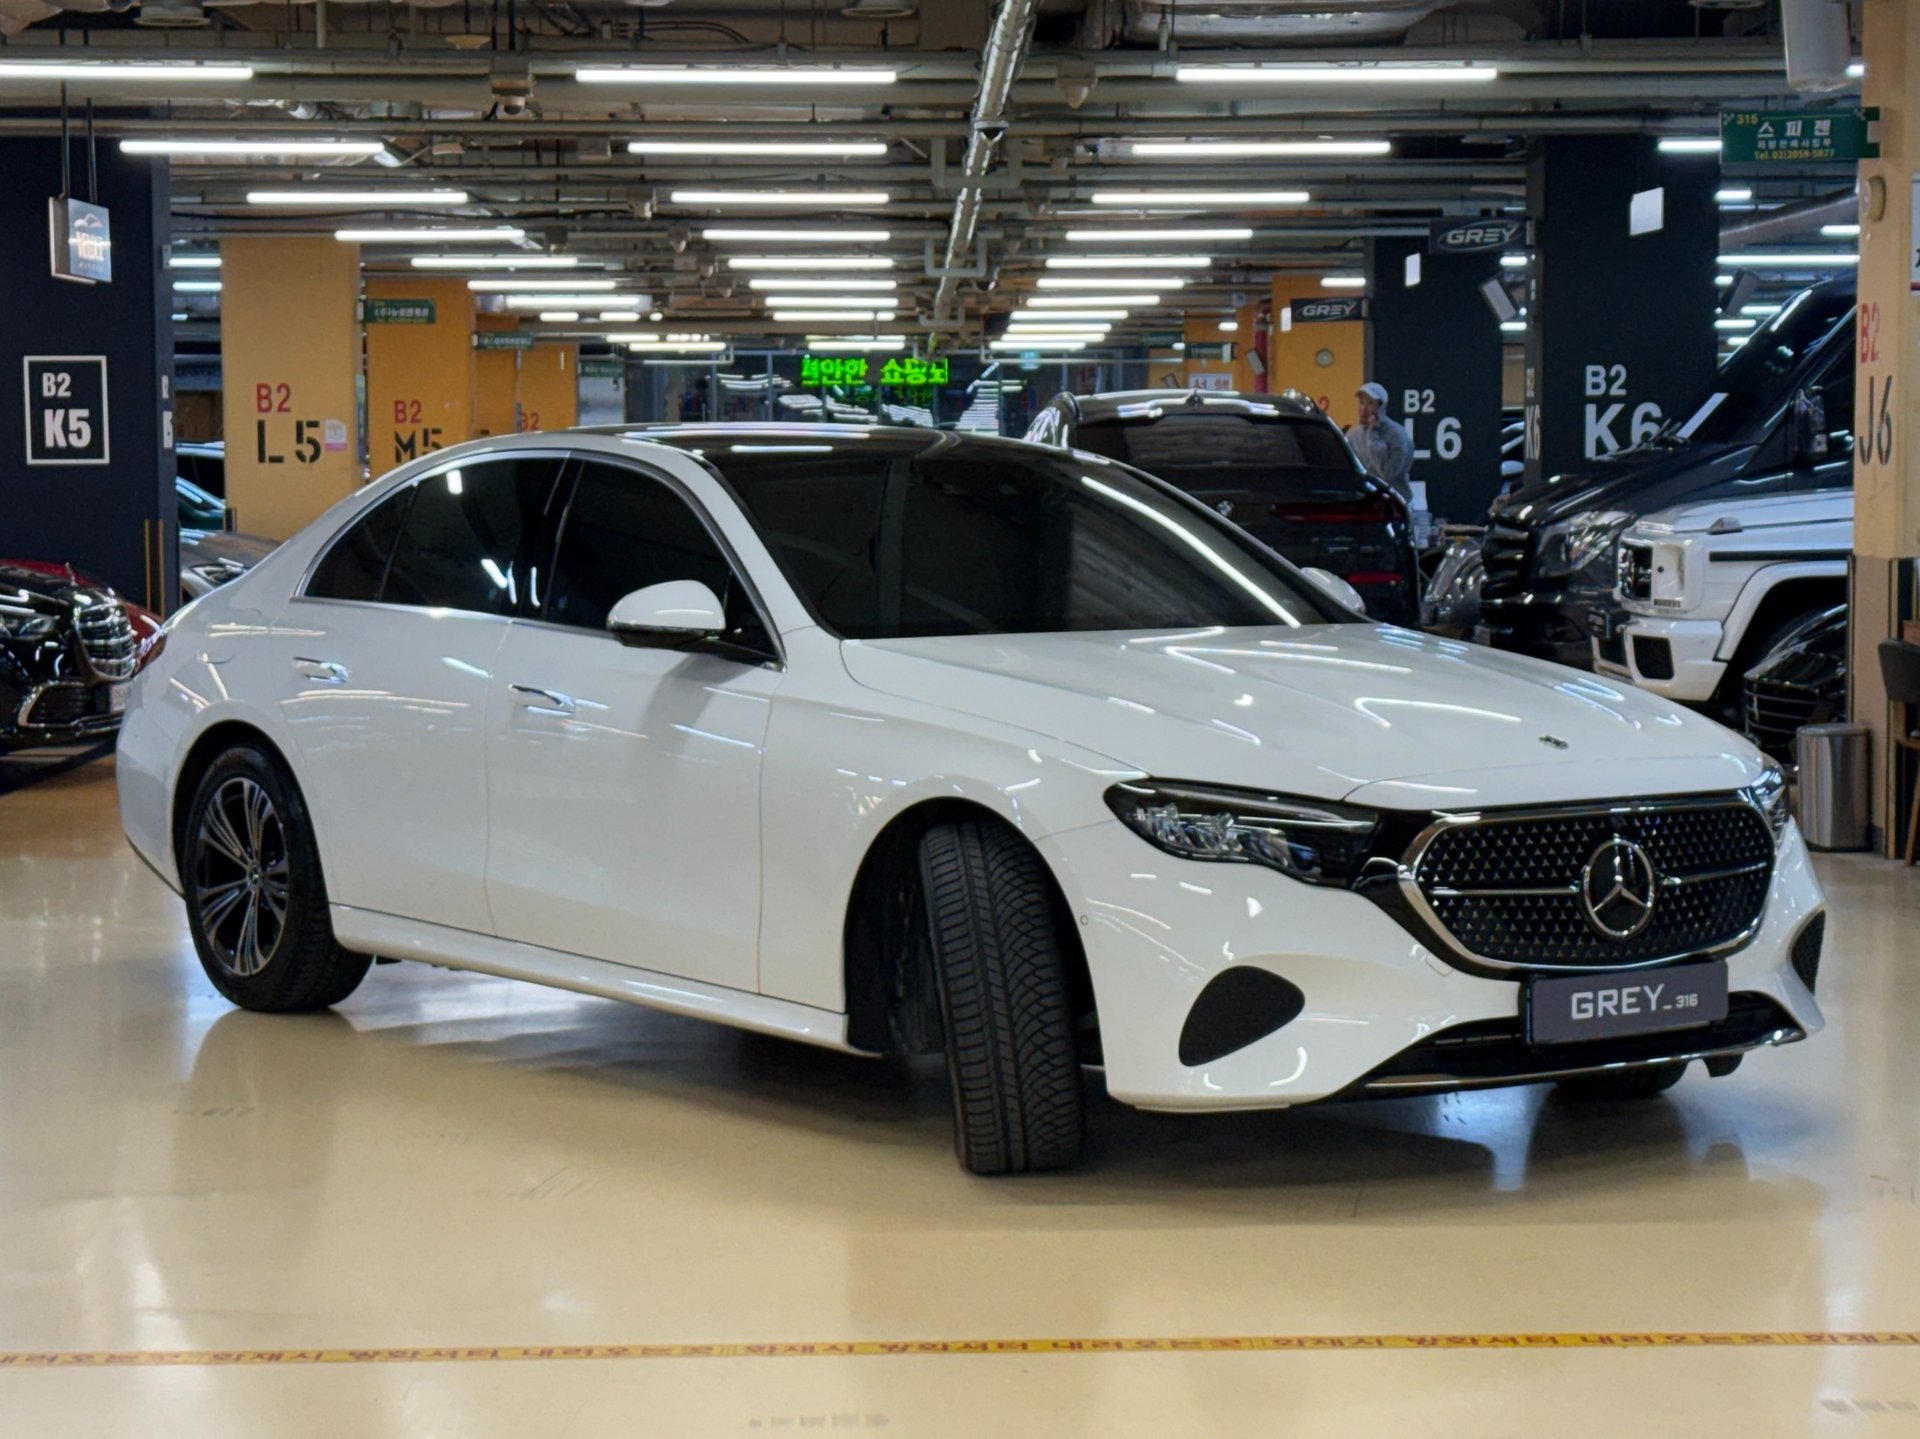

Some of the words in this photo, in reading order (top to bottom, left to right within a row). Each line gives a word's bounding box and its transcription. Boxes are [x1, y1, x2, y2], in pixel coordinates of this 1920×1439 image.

[1446, 223, 1518, 244] GREY
[1302, 303, 1355, 318] GREY
[1860, 303, 1880, 363] B2
[42, 372, 72, 397] B2
[1585, 364, 1627, 396] B2
[256, 383, 292, 413] B2
[394, 400, 422, 423] B2
[1404, 389, 1435, 412] B2
[44, 409, 92, 448] K5
[1859, 375, 1893, 466] J6
[257, 419, 321, 463] L5
